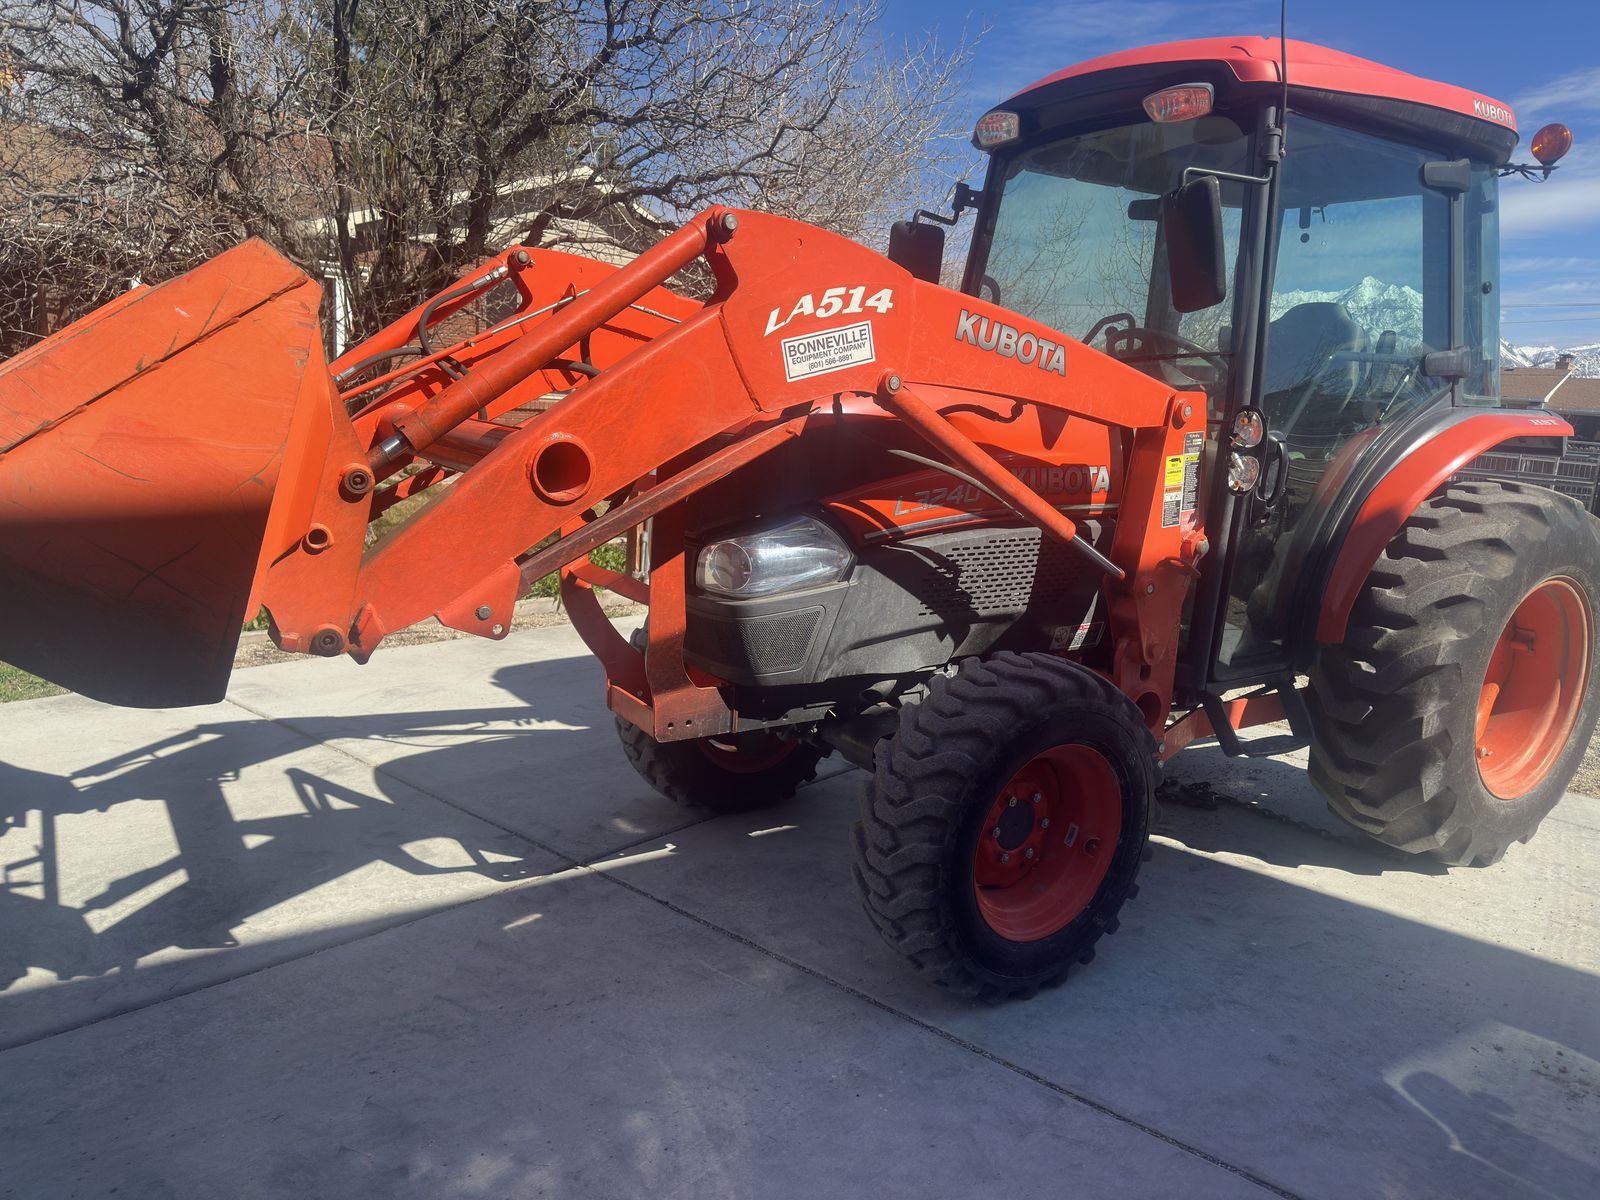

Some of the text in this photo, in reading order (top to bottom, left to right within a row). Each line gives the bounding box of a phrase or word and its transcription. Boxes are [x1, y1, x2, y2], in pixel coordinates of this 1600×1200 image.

[1473, 99, 1513, 125] KUBOTA
[764, 286, 893, 336] LA514
[787, 328, 868, 357] BONNEVILLE
[791, 341, 867, 365] EQUIPMENT COMPANY
[955, 308, 1066, 377] KUBOTA
